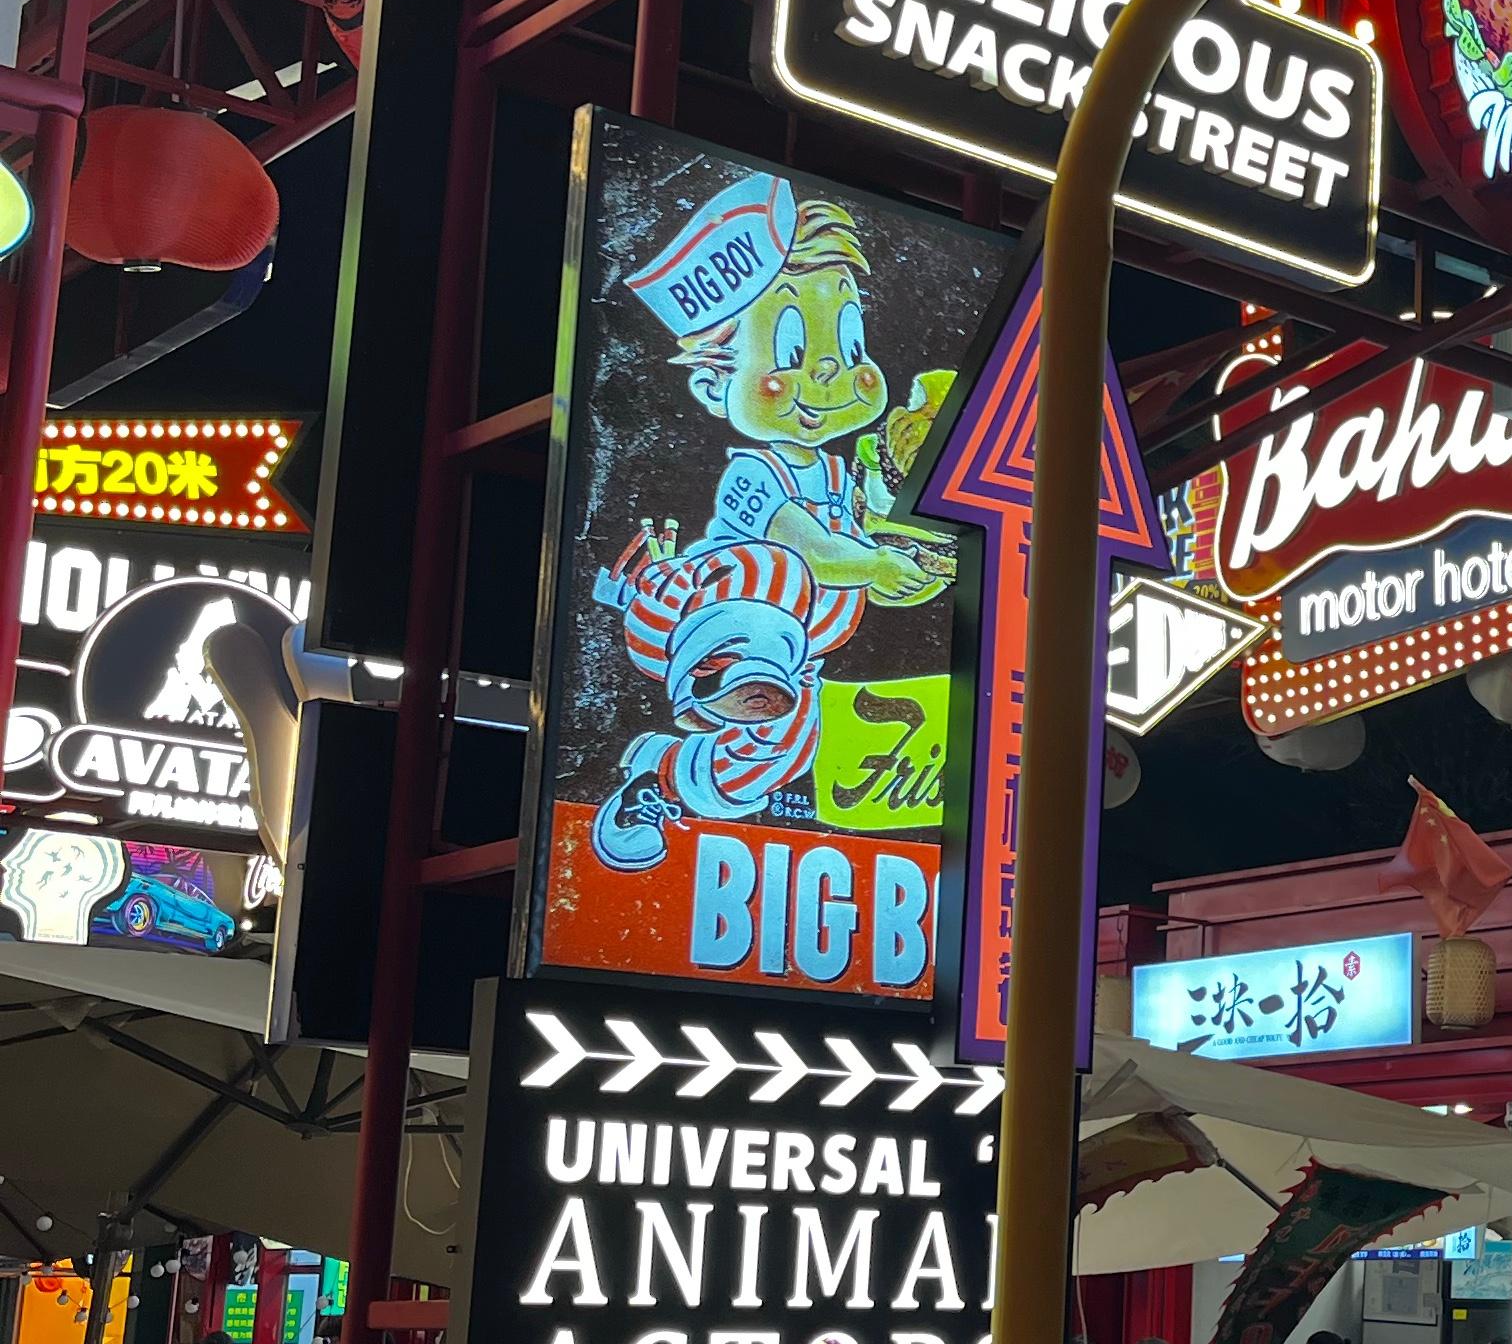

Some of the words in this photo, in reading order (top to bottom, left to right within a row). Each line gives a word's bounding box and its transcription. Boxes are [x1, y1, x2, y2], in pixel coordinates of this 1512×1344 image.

[1130, 92, 1349, 211] STREET
[669, 264, 725, 320] BIG
[709, 232, 764, 292] BOY
[723, 475, 752, 511] BIG
[738, 481, 772, 527] BOY
[1300, 568, 1425, 636] motor
[690, 833, 859, 982] BIG
[545, 1117, 942, 1197] UNIVERSAL
